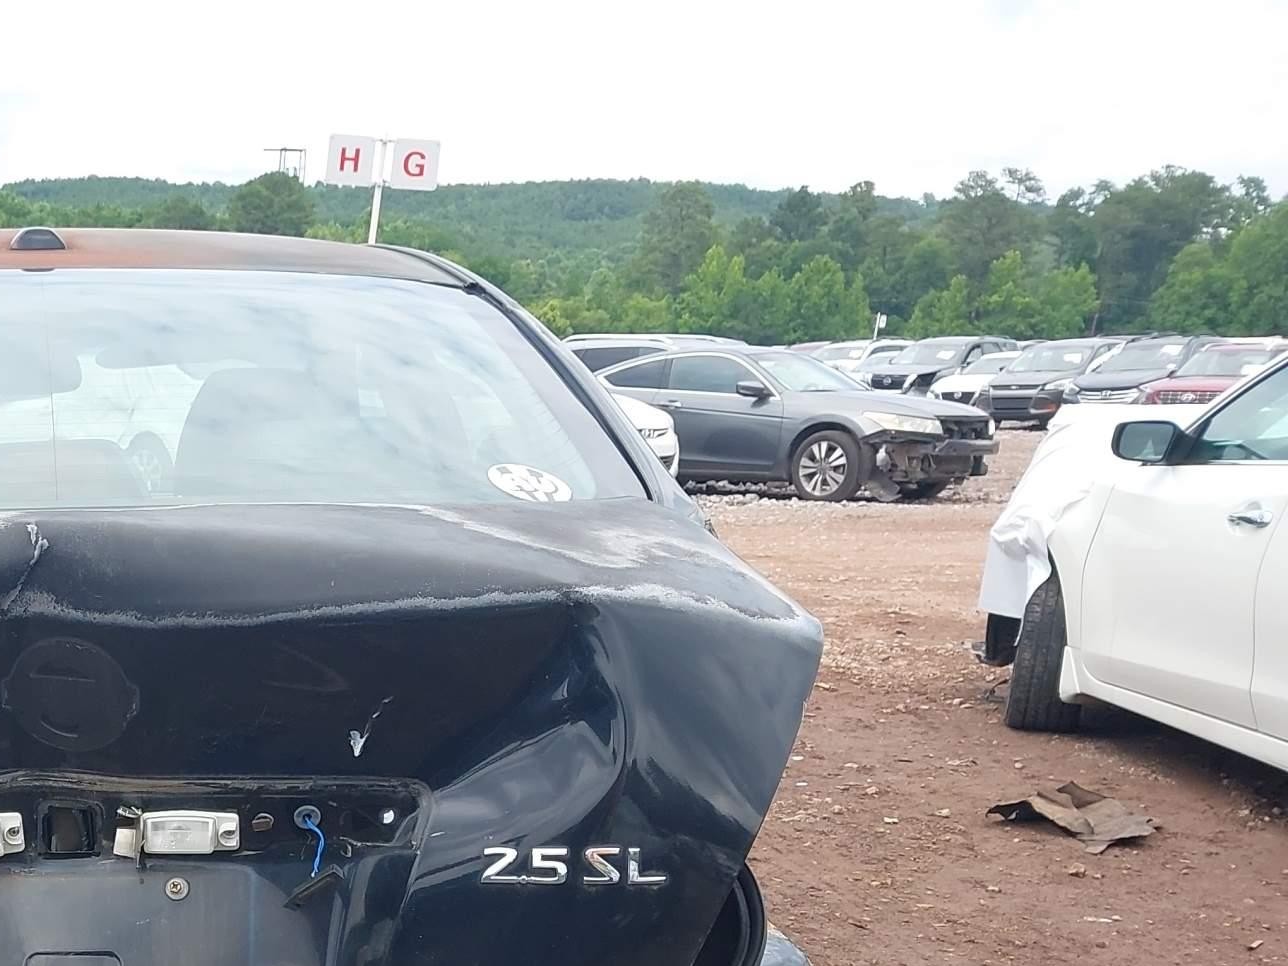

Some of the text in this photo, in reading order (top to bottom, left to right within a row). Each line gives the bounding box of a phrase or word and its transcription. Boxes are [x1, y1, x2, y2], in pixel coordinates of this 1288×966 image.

[339, 147, 360, 172] H
[403, 151, 426, 177] G
[583, 847, 667, 884] SL
